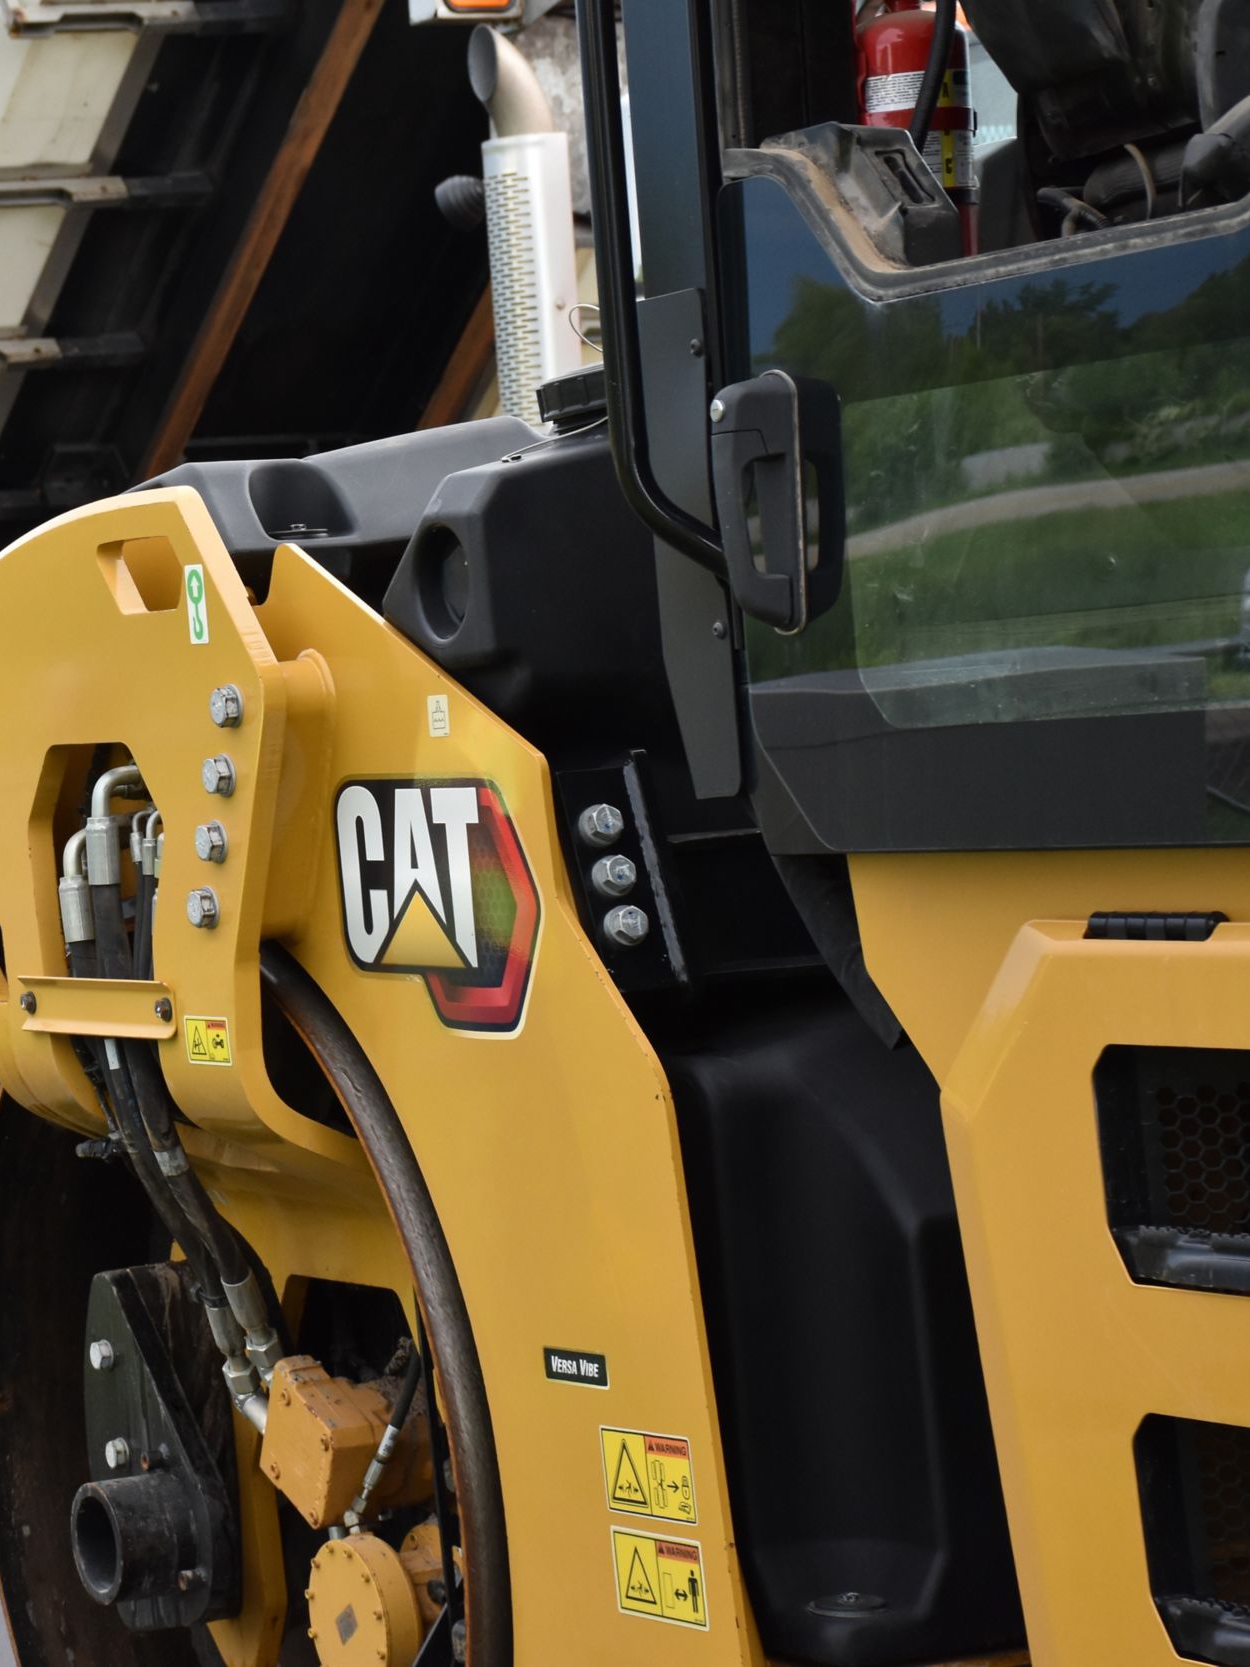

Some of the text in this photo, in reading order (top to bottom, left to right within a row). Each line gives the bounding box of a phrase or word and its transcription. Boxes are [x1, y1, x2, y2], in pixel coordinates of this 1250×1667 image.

[336, 785, 479, 969] CAT
[551, 1355, 599, 1378] VERSA VIBE
[655, 1443, 687, 1456] WARNING
[665, 1545, 698, 1561] WARNING
